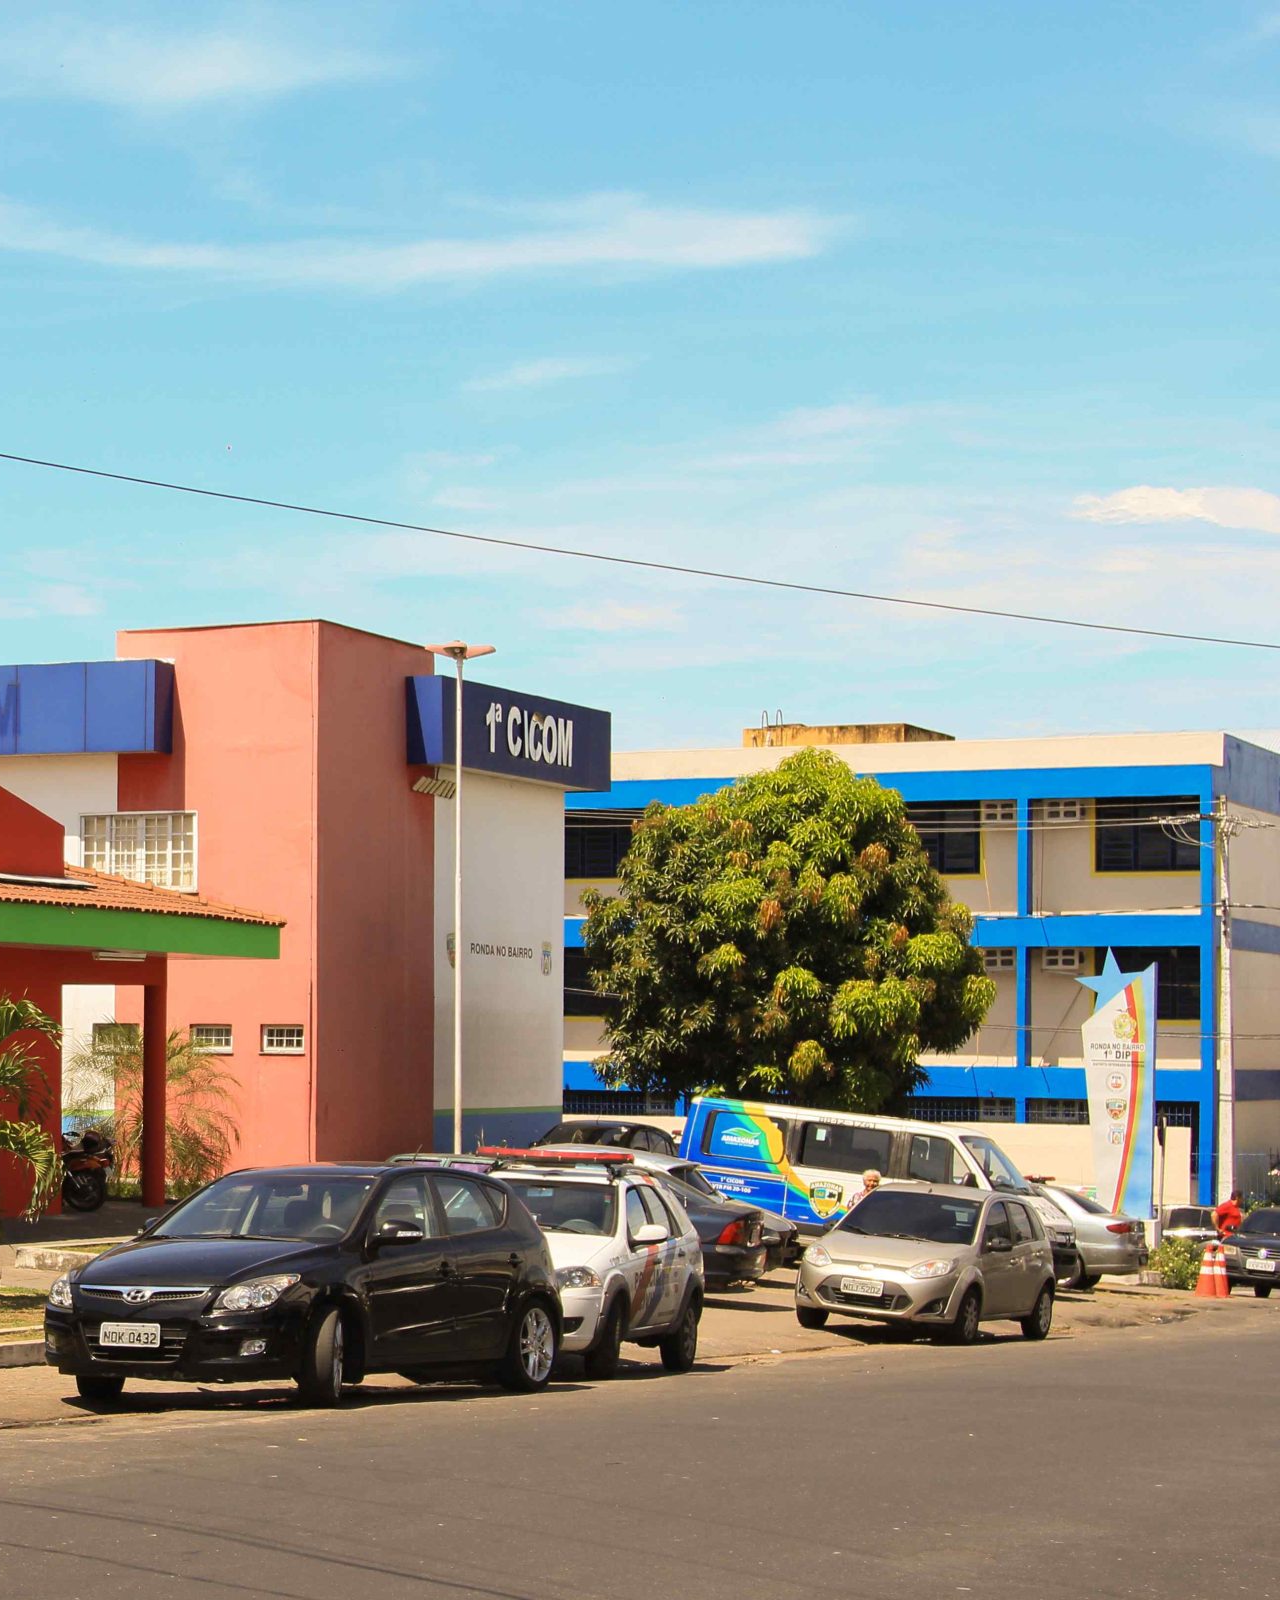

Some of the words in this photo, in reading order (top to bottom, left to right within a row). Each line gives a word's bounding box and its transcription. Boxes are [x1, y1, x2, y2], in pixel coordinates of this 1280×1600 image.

[507, 706, 574, 768] CICOM
[470, 942, 495, 956] RONDA
[496, 945, 506, 958] NO
[507, 946, 533, 960] BAIRRO
[1090, 1042, 1111, 1050] RONDA
[1115, 1050, 1131, 1060] DIP
[721, 1134, 760, 1146] AMAZONAS
[128, 1332, 157, 1345] 0432
